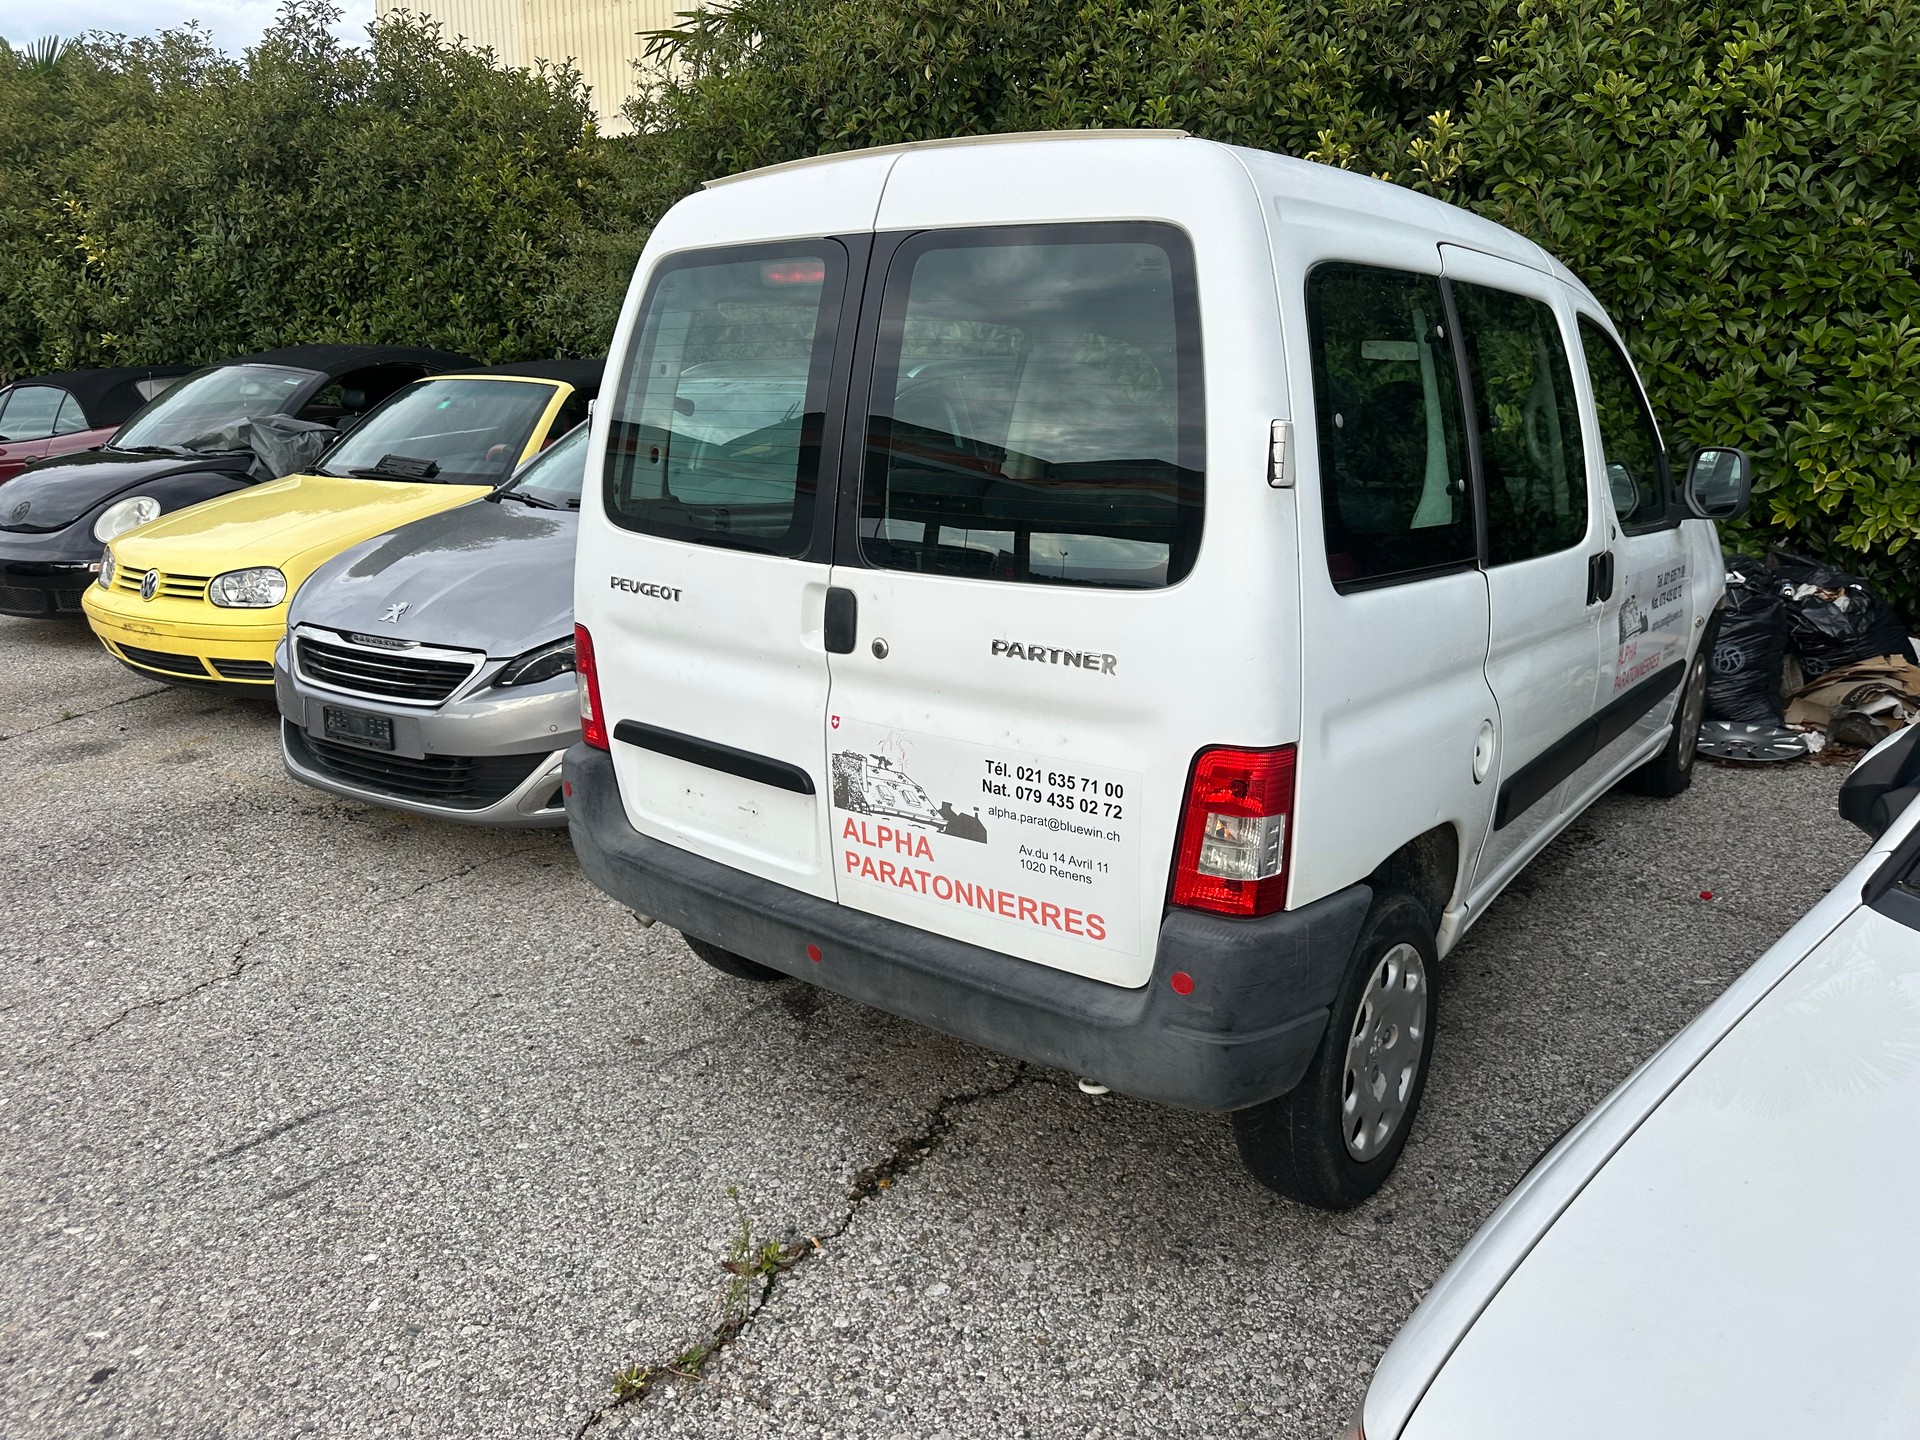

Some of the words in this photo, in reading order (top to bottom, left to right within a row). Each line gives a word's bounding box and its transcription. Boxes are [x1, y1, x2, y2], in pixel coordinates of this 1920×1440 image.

[610, 576, 683, 602] PEUGEOT
[991, 638, 1117, 676] PARTNER
[985, 760, 1011, 778] Tél.
[1016, 766, 1042, 784] 021
[1048, 772, 1076, 790] 635
[1080, 777, 1098, 794] 71
[1104, 782, 1124, 799] 00
[982, 779, 1011, 798] Nat.
[1015, 786, 1042, 803] 079
[1046, 792, 1075, 810] 435
[1079, 799, 1098, 815] 02
[1103, 802, 1123, 820] 72
[842, 816, 935, 862] ALPHA
[988, 805, 1121, 842] alpha.parat@bluewin.ch
[1018, 844, 1049, 860] Av.du
[1052, 852, 1066, 864] 14
[1068, 855, 1093, 870] Avril
[1096, 862, 1109, 874] 11
[1020, 859, 1046, 874] 1020
[1049, 864, 1092, 885] Renens
[844, 850, 1107, 941] PARATONNERRES
